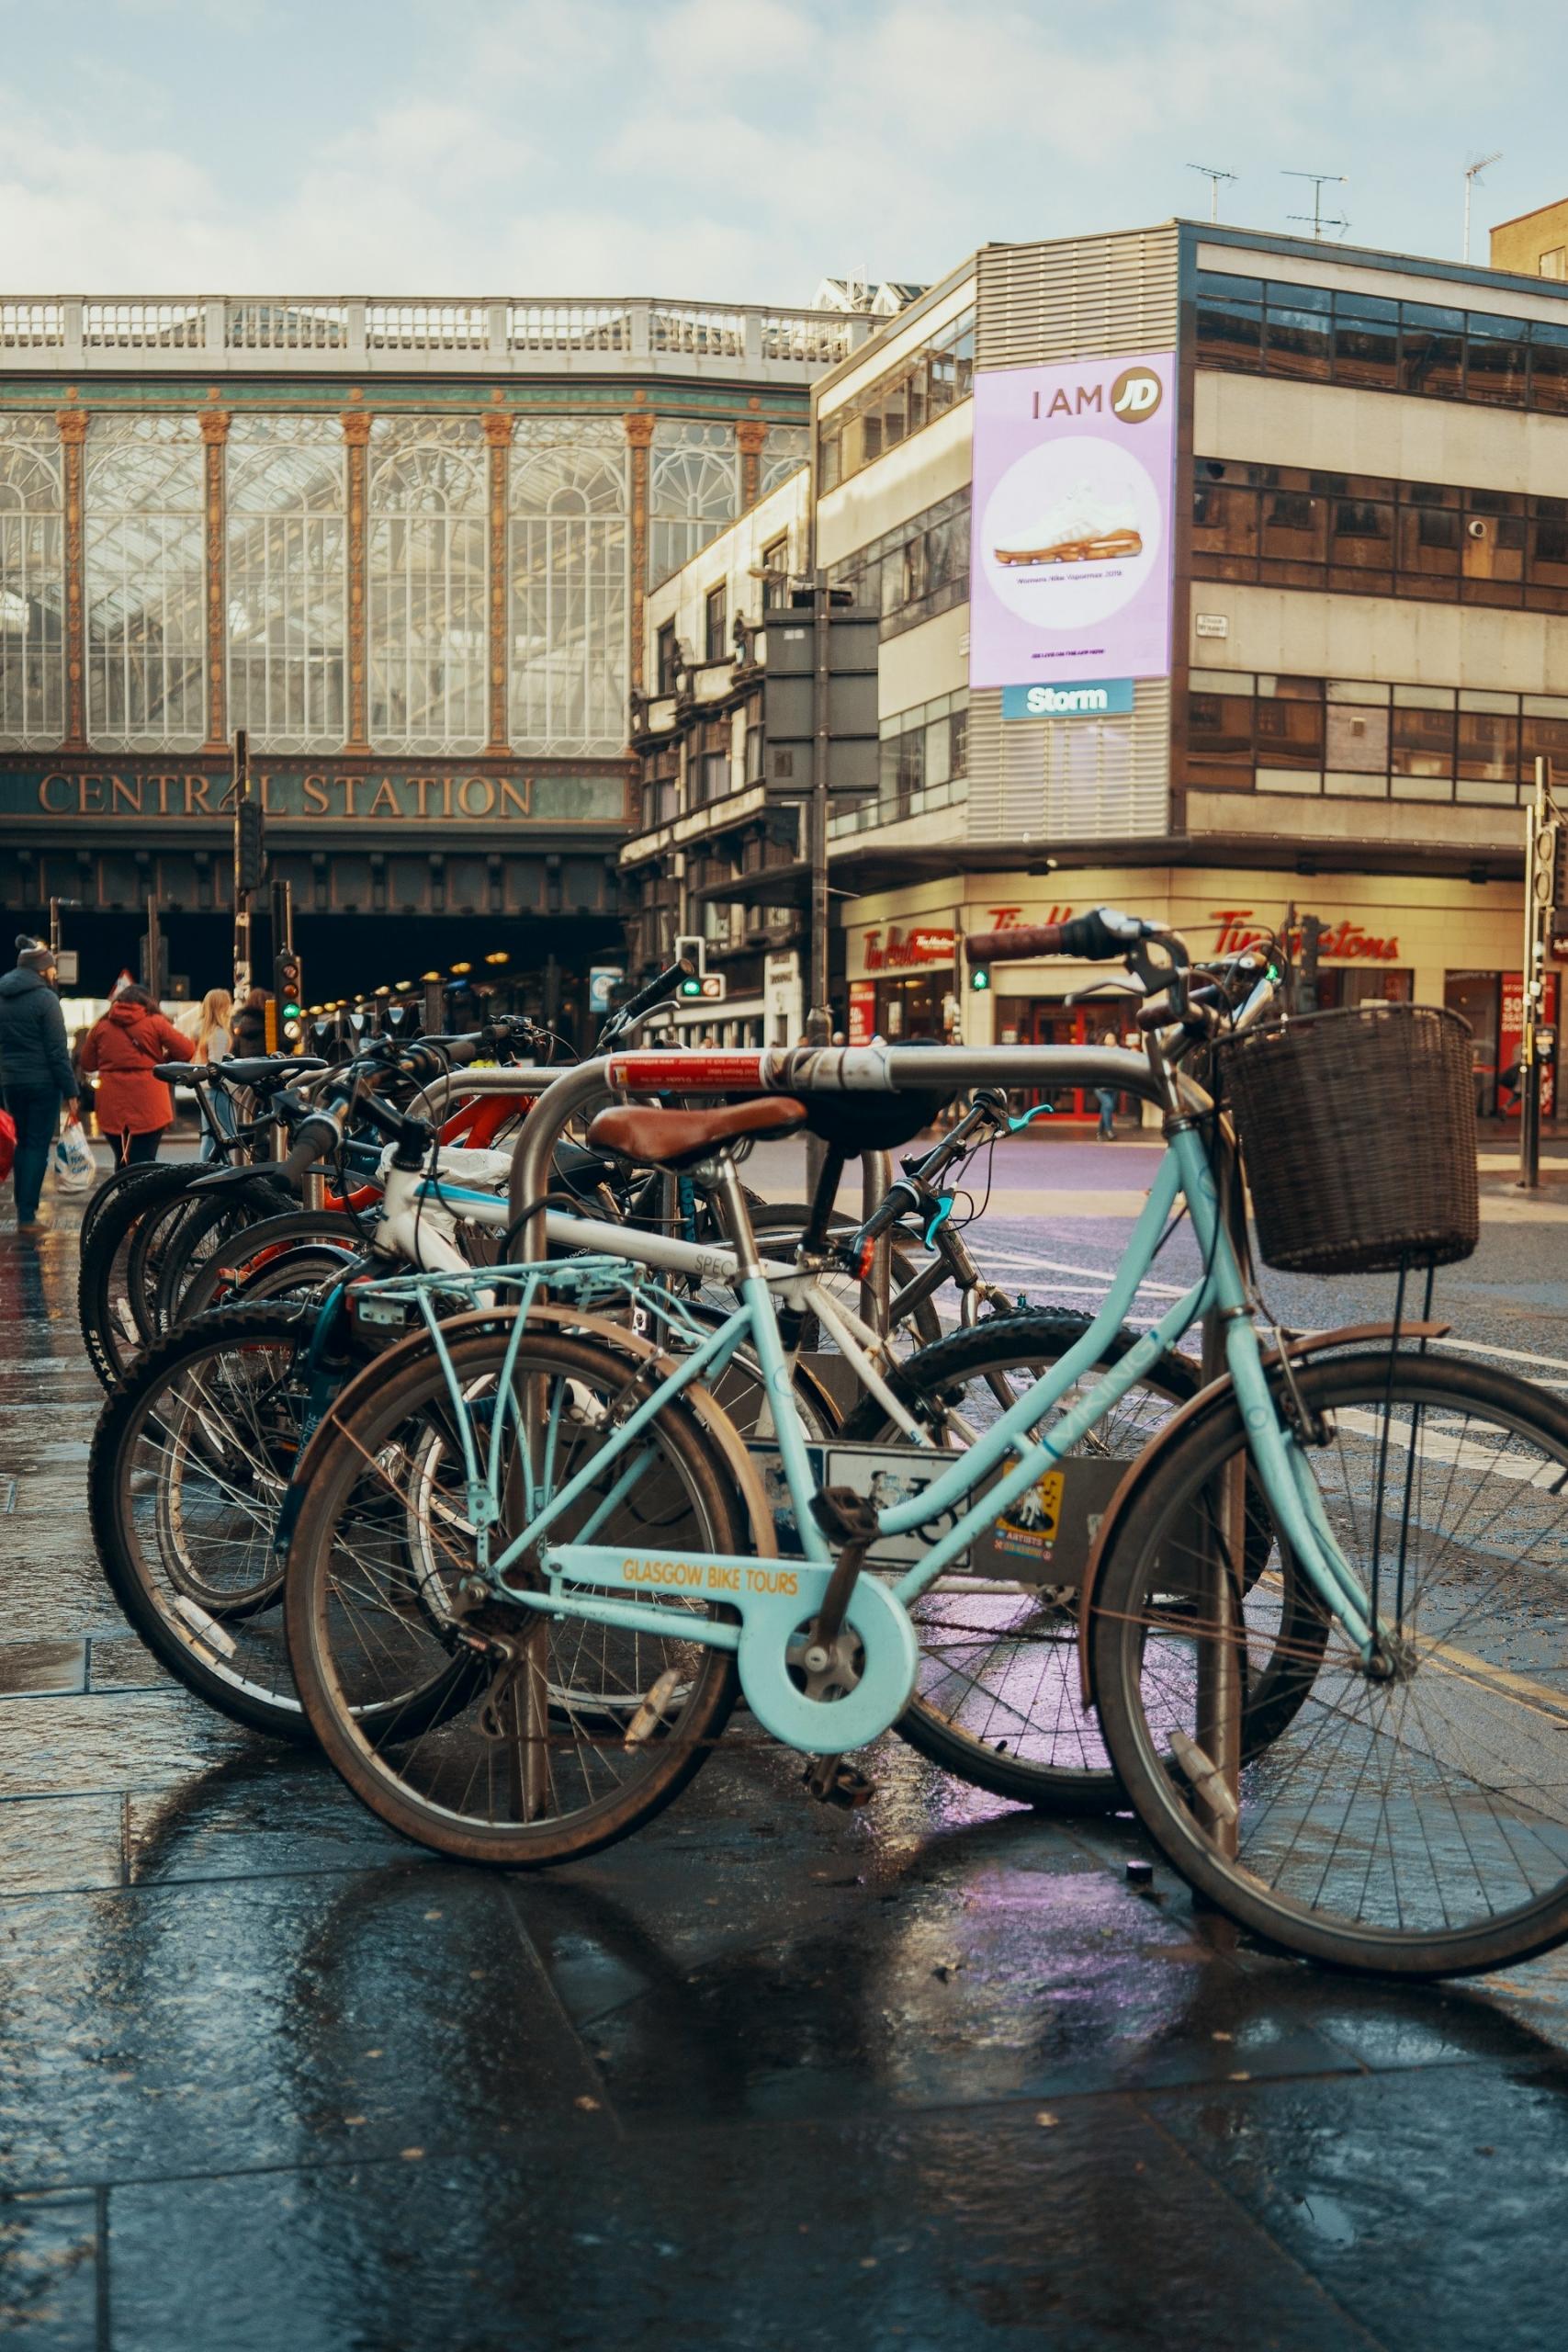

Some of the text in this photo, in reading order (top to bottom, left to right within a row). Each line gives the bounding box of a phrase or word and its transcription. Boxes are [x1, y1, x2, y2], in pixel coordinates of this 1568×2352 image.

[1032, 378, 1159, 420] I AM JD
[1026, 686, 1108, 714] Storm
[303, 775, 532, 818] STATION
[623, 1557, 798, 1596] GLASGOW BIKE TOURS
